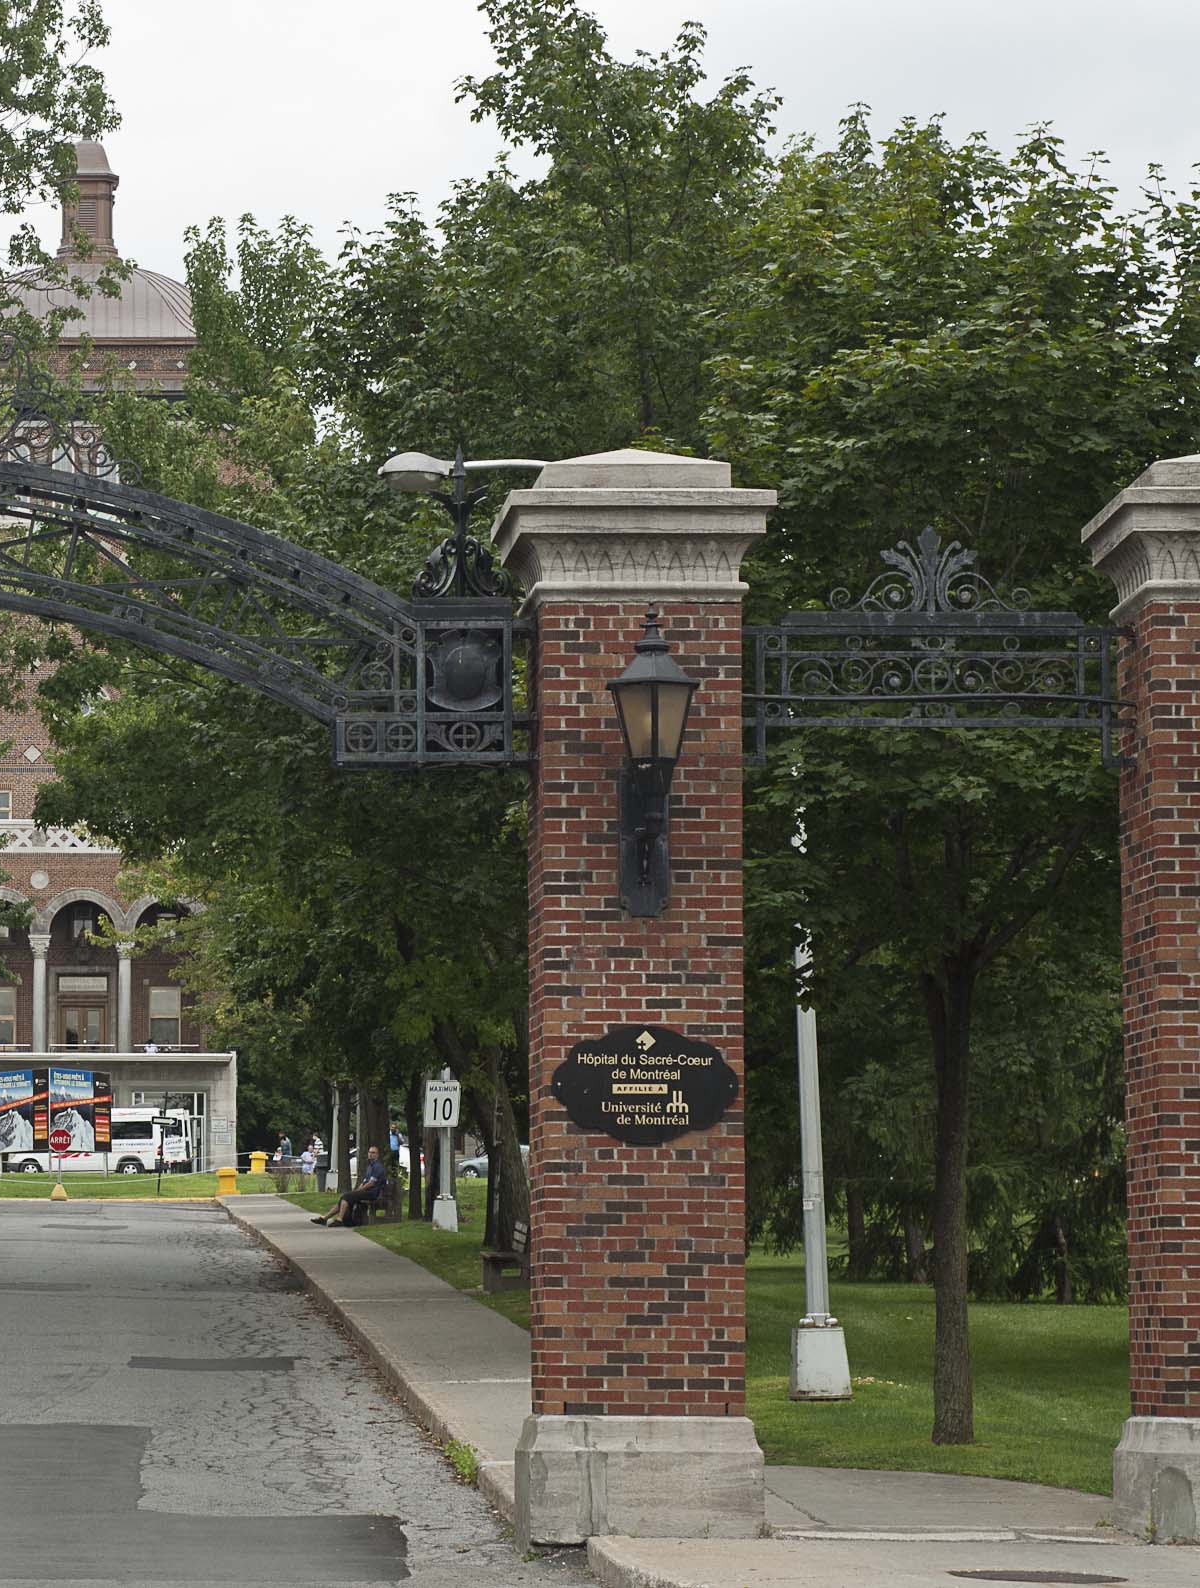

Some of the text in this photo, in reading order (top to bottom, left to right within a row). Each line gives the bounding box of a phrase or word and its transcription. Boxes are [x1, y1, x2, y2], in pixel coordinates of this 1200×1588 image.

[577, 1053, 618, 1067] Hôpital
[621, 1054, 636, 1065] du
[611, 1068, 681, 1080] de Montréal
[433, 1098, 453, 1120] 10
[601, 1101, 662, 1113] Université
[616, 1114, 689, 1125] de Montréal
[50, 1136, 71, 1144] ARRÊT
